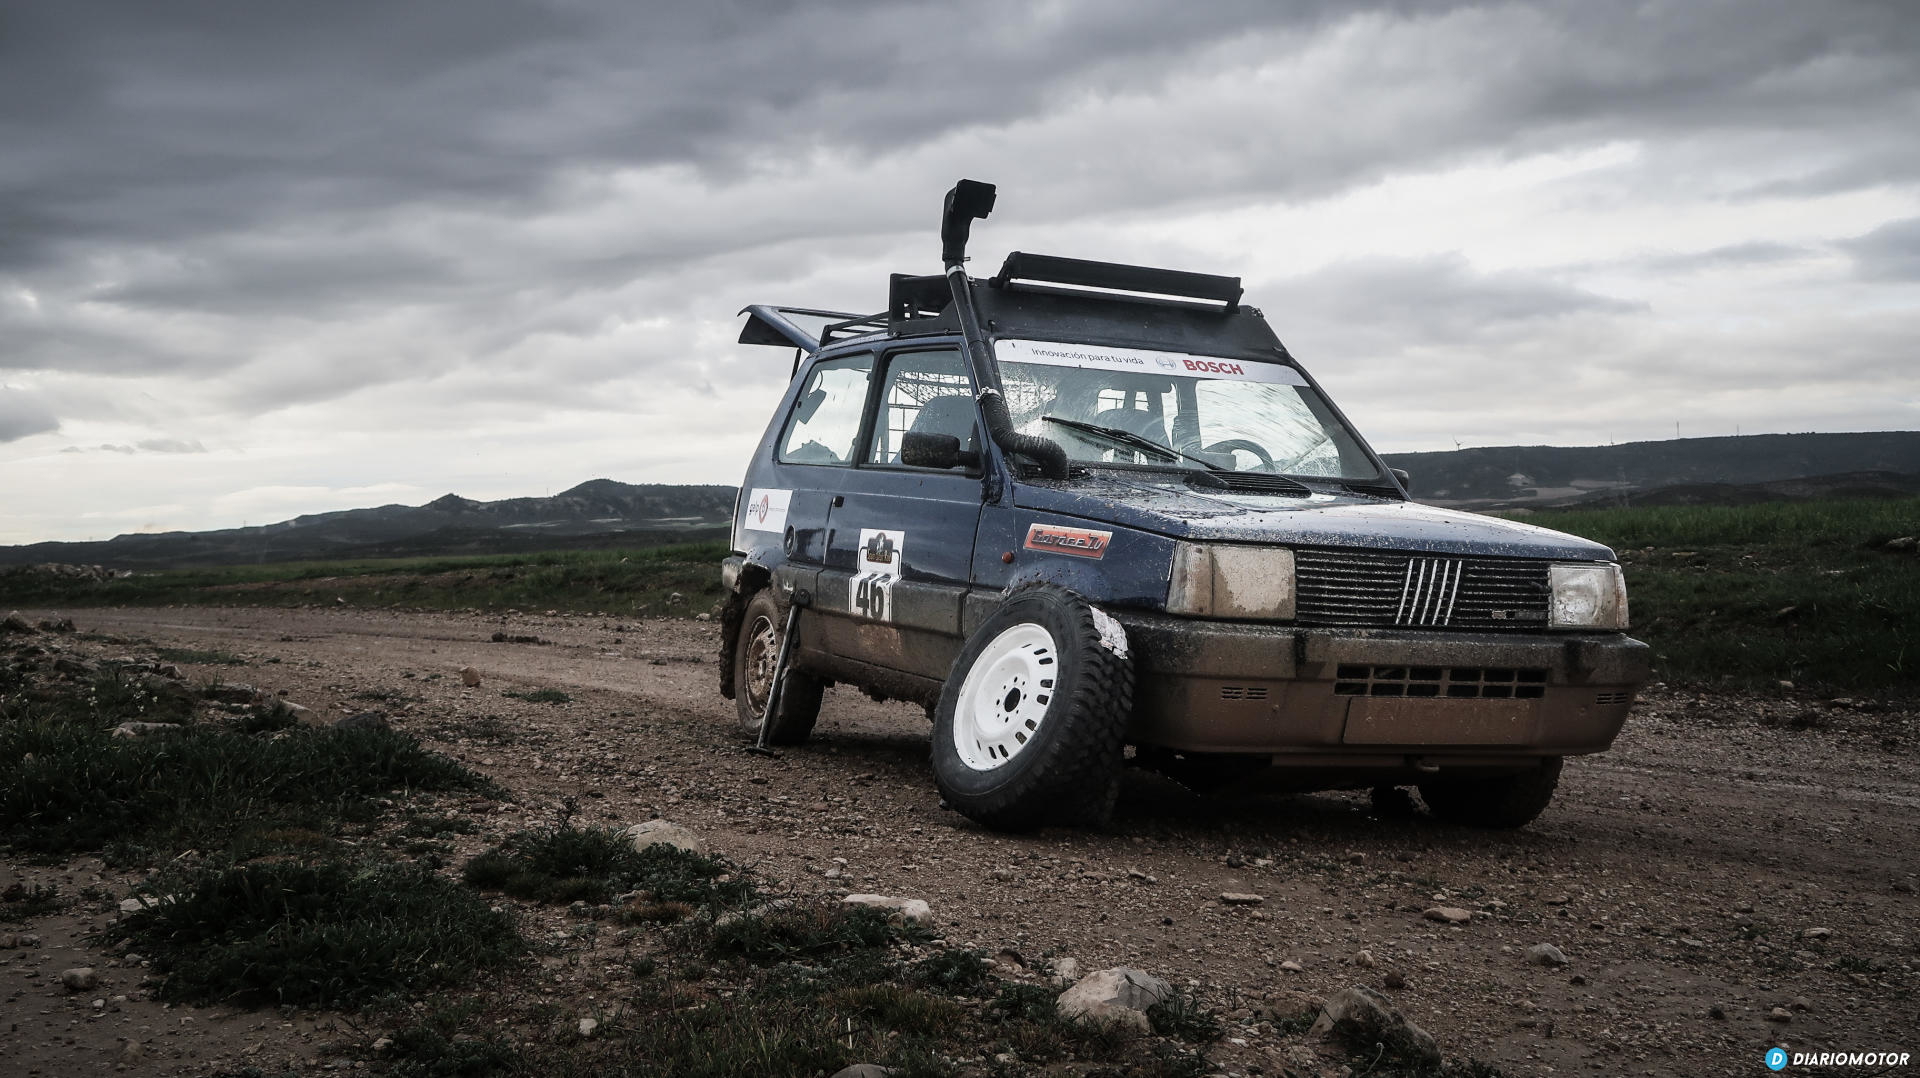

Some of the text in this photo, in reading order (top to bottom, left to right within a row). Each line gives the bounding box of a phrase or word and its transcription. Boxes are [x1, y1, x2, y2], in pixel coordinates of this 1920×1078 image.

[1031, 348, 1087, 360] Innovación
[1088, 353, 1111, 362] para
[1124, 357, 1145, 365] vida
[1182, 359, 1245, 376] BOSCH
[856, 573, 892, 619] 46
